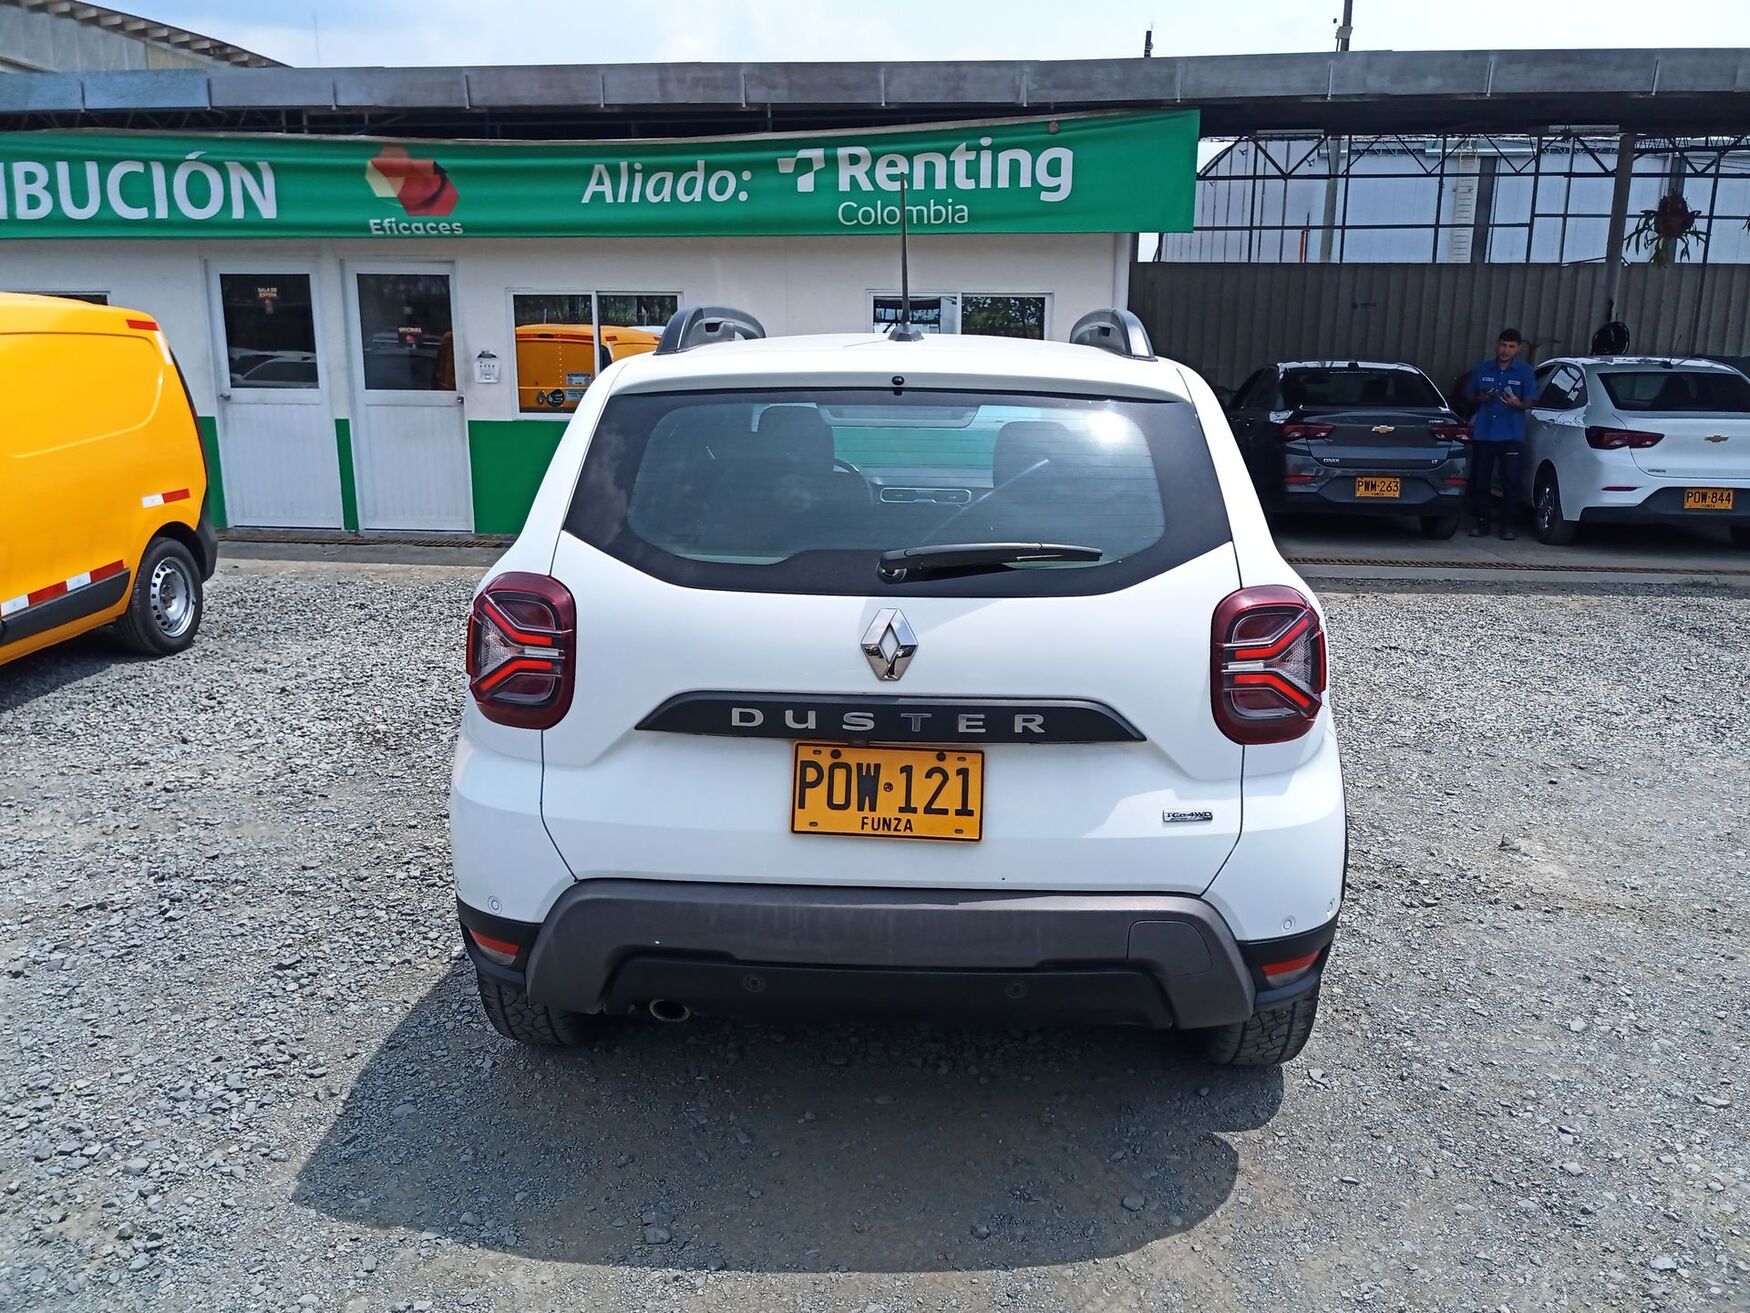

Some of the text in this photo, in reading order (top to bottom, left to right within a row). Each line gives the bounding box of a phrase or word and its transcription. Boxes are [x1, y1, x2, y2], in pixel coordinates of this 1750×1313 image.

[581, 160, 752, 204] Aliado:
[837, 137, 1074, 202] Renting
[837, 199, 969, 226] Colombia
[369, 218, 464, 236] Eficaces
[1380, 481, 1399, 493] 263
[731, 707, 1045, 734] DUSTER
[798, 760, 975, 817] POW 121
[861, 816, 913, 833] FUNZA
